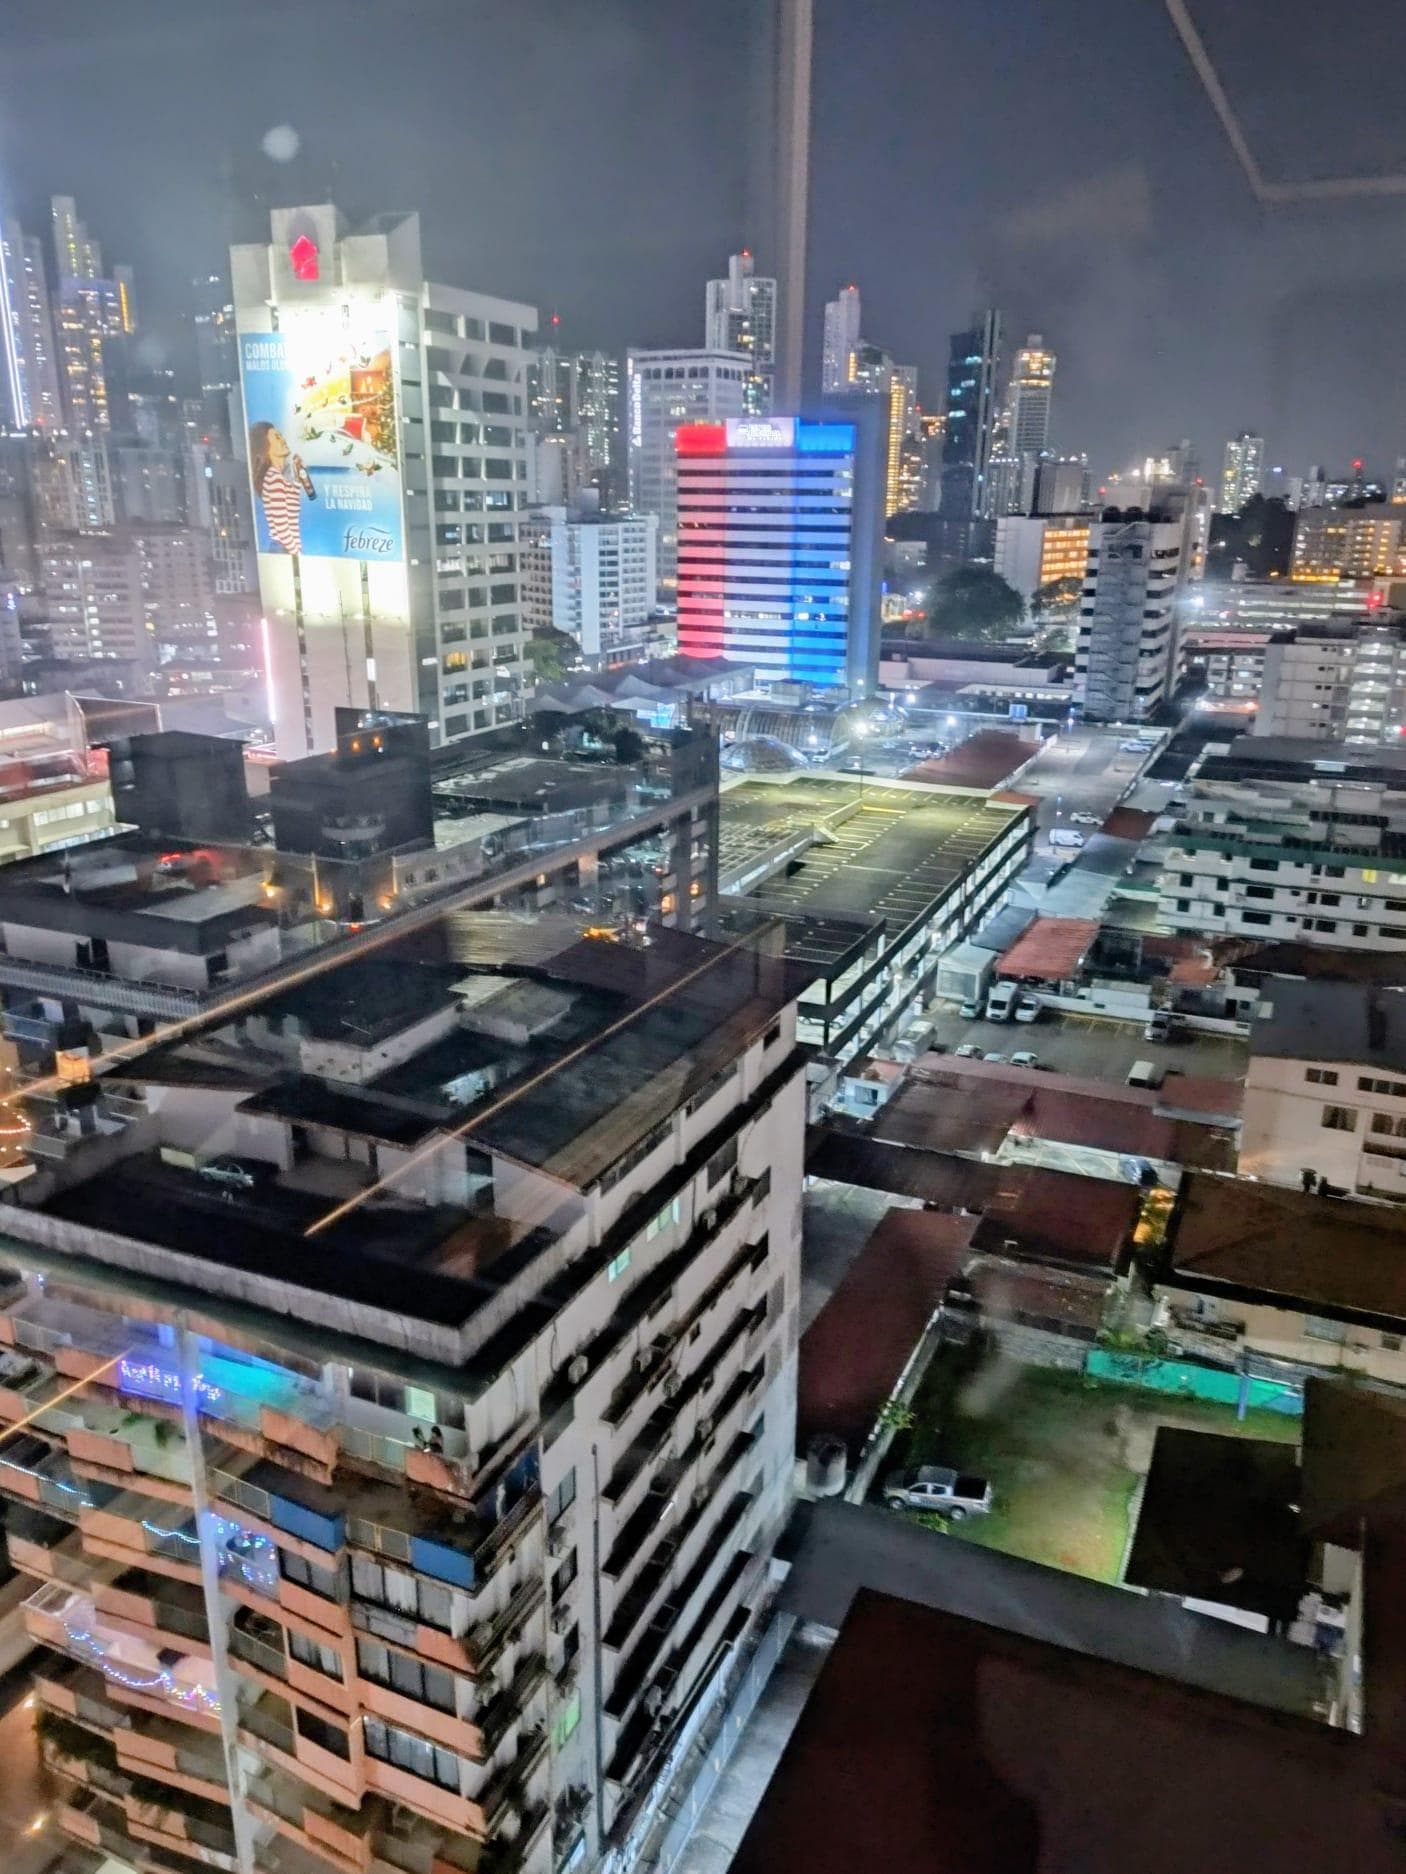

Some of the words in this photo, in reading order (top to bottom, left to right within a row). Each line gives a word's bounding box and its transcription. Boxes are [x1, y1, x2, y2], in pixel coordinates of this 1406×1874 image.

[325, 497, 336, 510] LA
[337, 498, 374, 511] NAVIDAD
[344, 525, 394, 552] febreze
